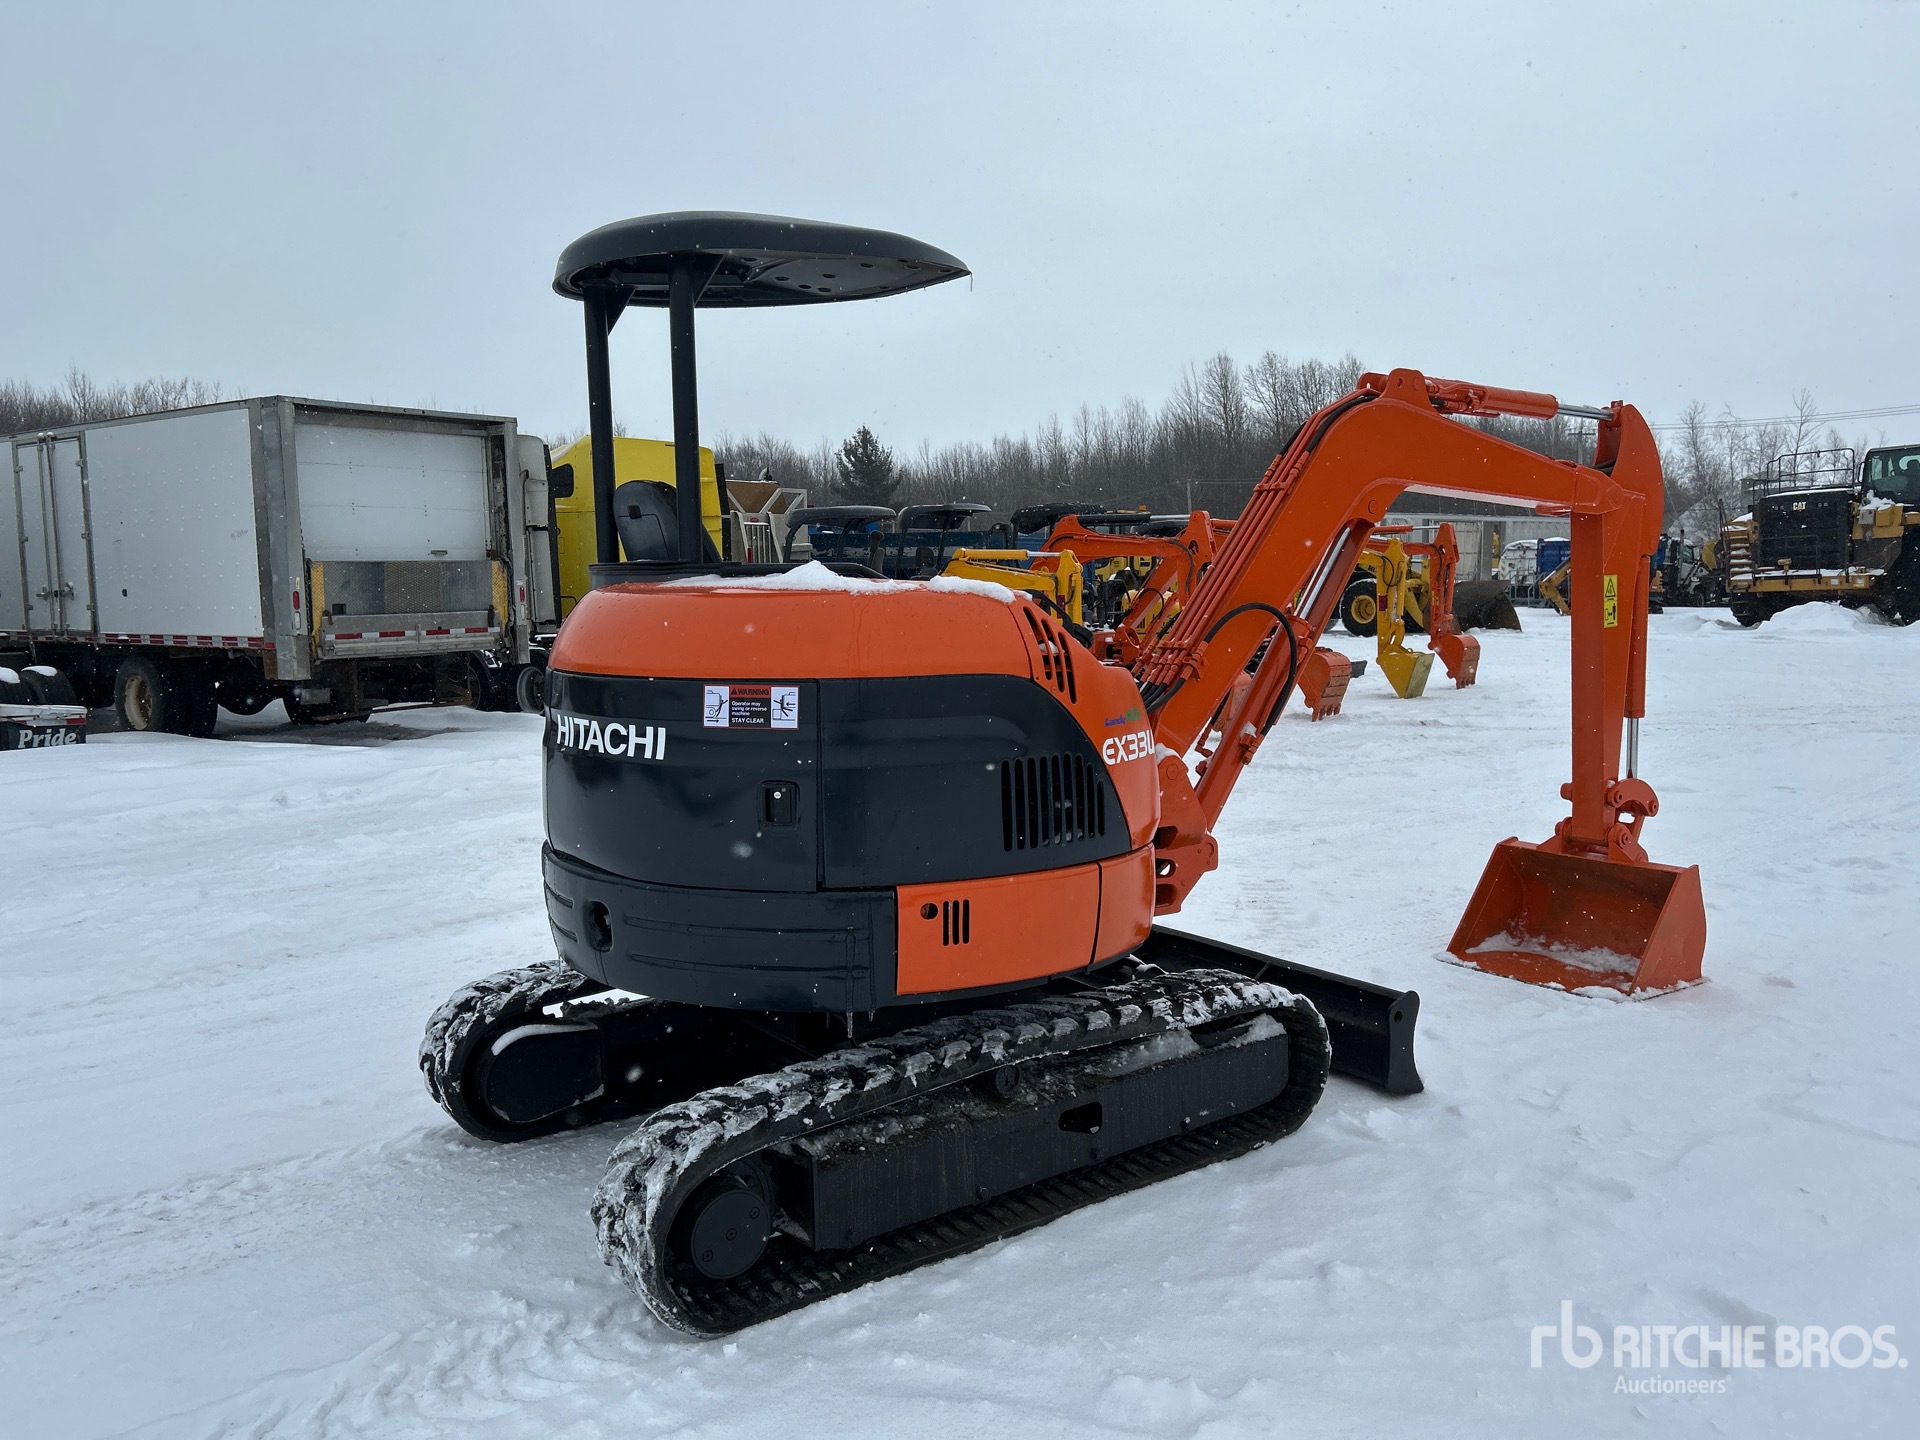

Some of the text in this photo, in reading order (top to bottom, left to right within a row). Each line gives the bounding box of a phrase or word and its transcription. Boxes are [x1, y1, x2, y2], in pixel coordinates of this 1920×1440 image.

[1792, 501, 1807, 511] CAT
[17, 728, 77, 749] Pride
[556, 713, 666, 760] HITACHI
